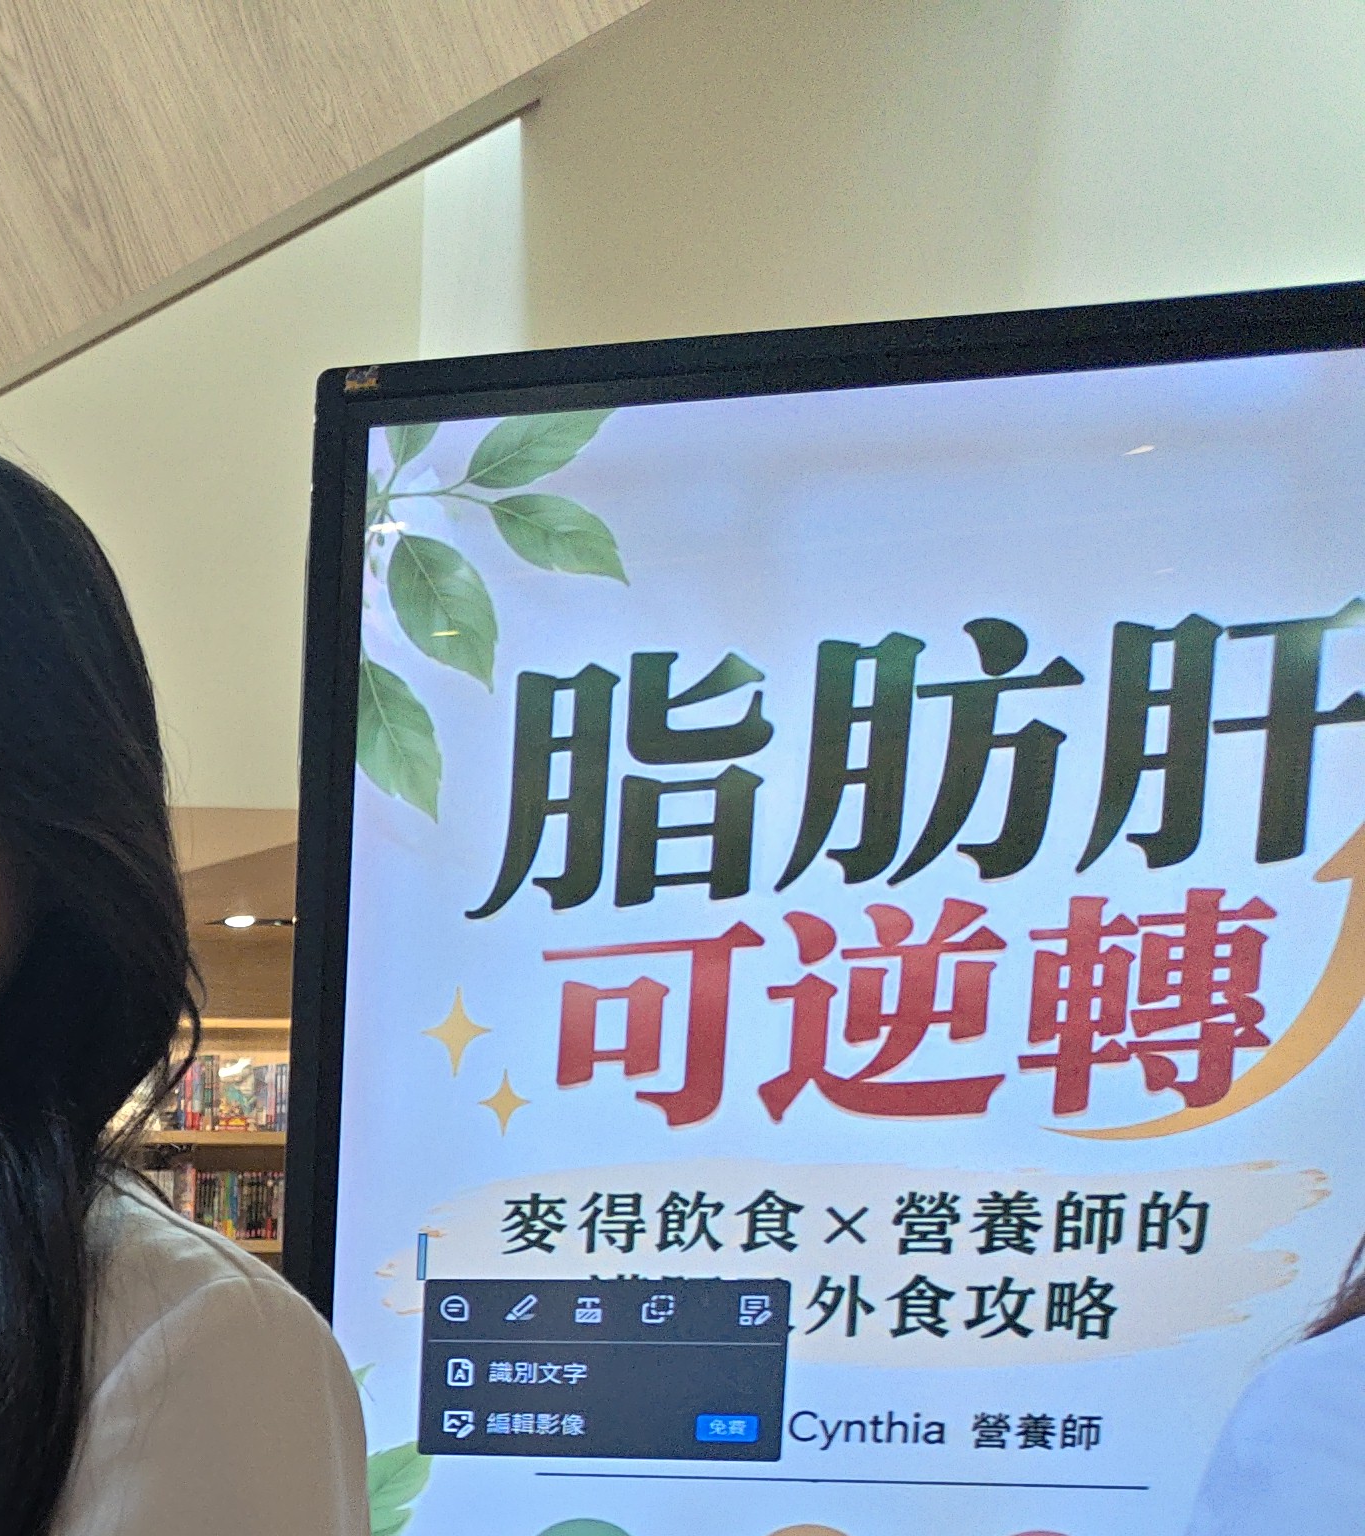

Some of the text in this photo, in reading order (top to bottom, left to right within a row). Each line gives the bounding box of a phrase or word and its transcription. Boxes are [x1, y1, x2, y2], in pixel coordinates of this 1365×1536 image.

[465, 598, 1365, 920] 脂肪肝
[542, 888, 1277, 1127] 可逆轉
[589, 1275, 1118, 1341] 外食攻略
[488, 1361, 588, 1385] 識別文字
[486, 1412, 747, 1437] 編輯影像 免費
[788, 1411, 1104, 1450] Cynthia 營養師
